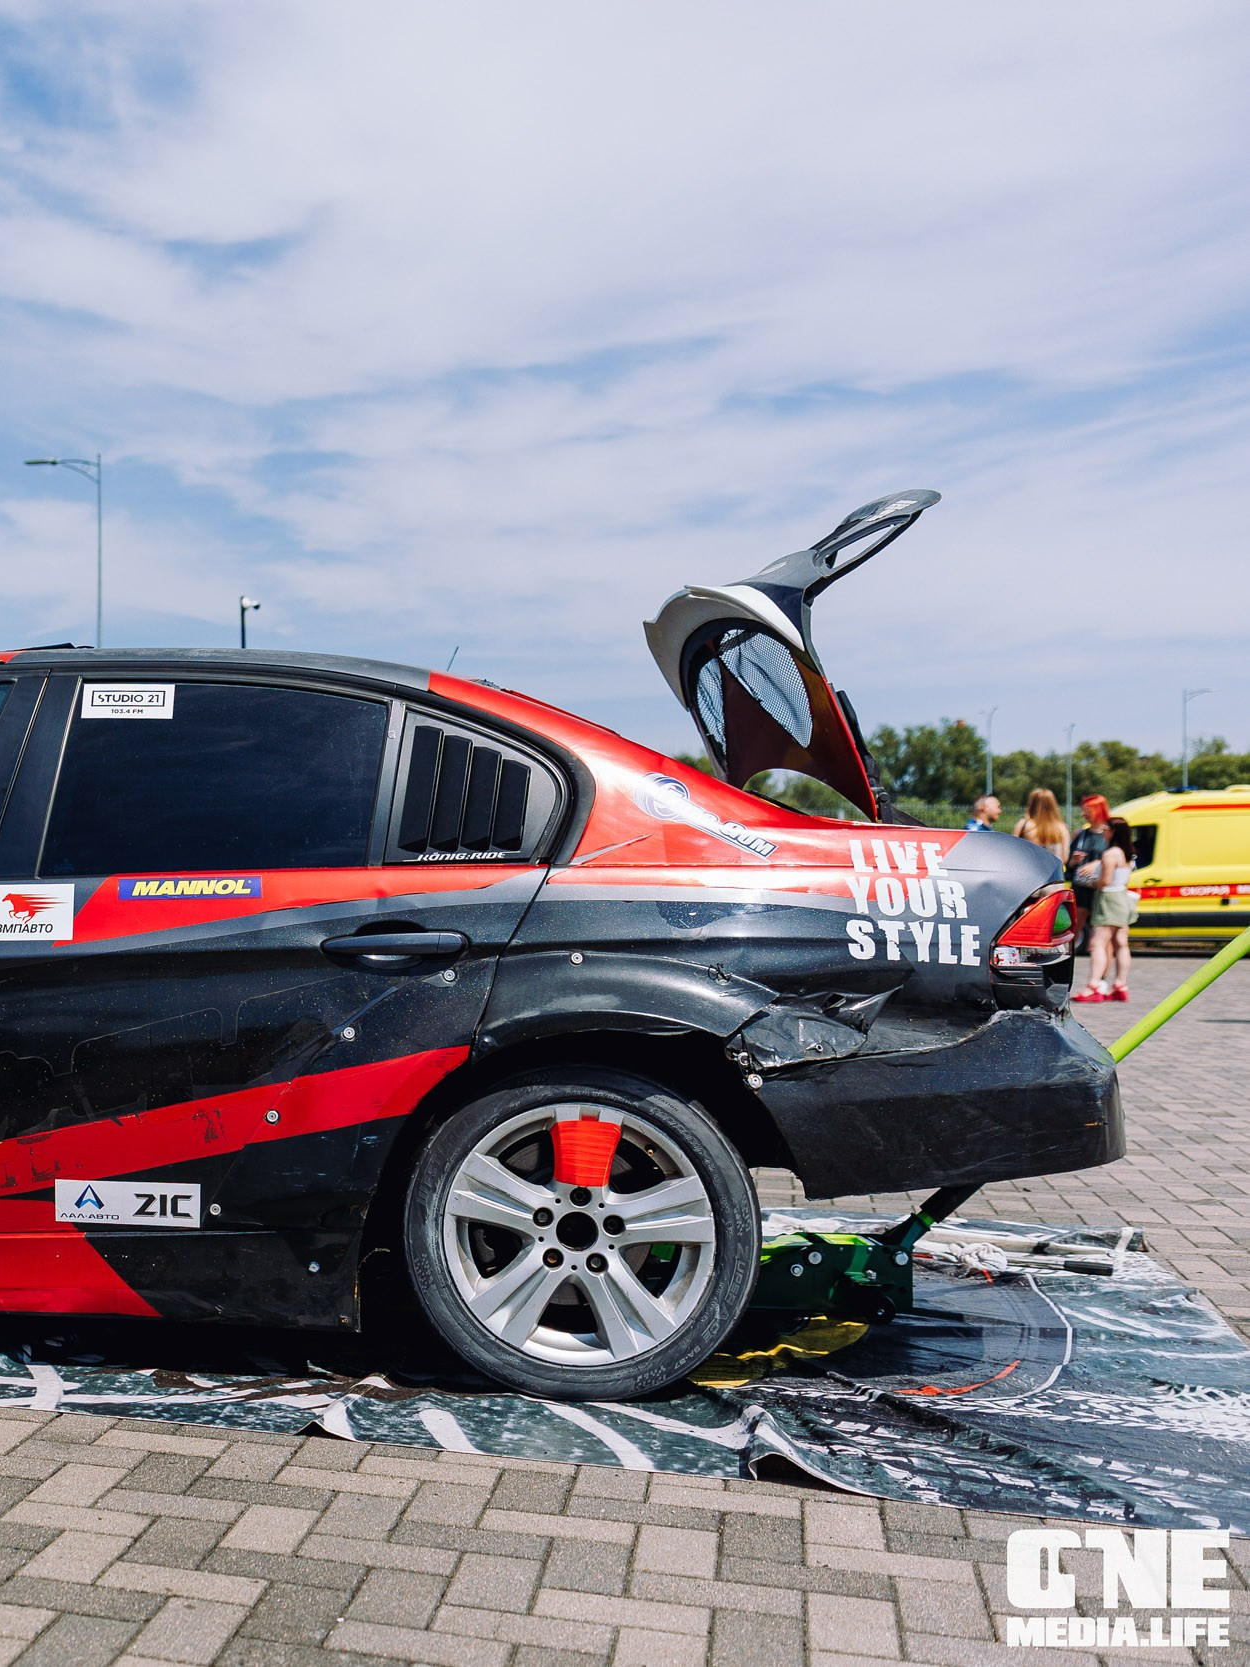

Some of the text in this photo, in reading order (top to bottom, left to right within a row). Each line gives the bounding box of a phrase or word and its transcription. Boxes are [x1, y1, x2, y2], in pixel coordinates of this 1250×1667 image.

[97, 694, 160, 703] STUDIO 21
[849, 839, 948, 877] LIVE
[132, 879, 251, 896] MANNOL
[845, 876, 968, 919] YOUR
[1179, 885, 1230, 896] СКОРАЯ
[845, 919, 981, 967] STYLE
[132, 1193, 194, 1219] ZIC
